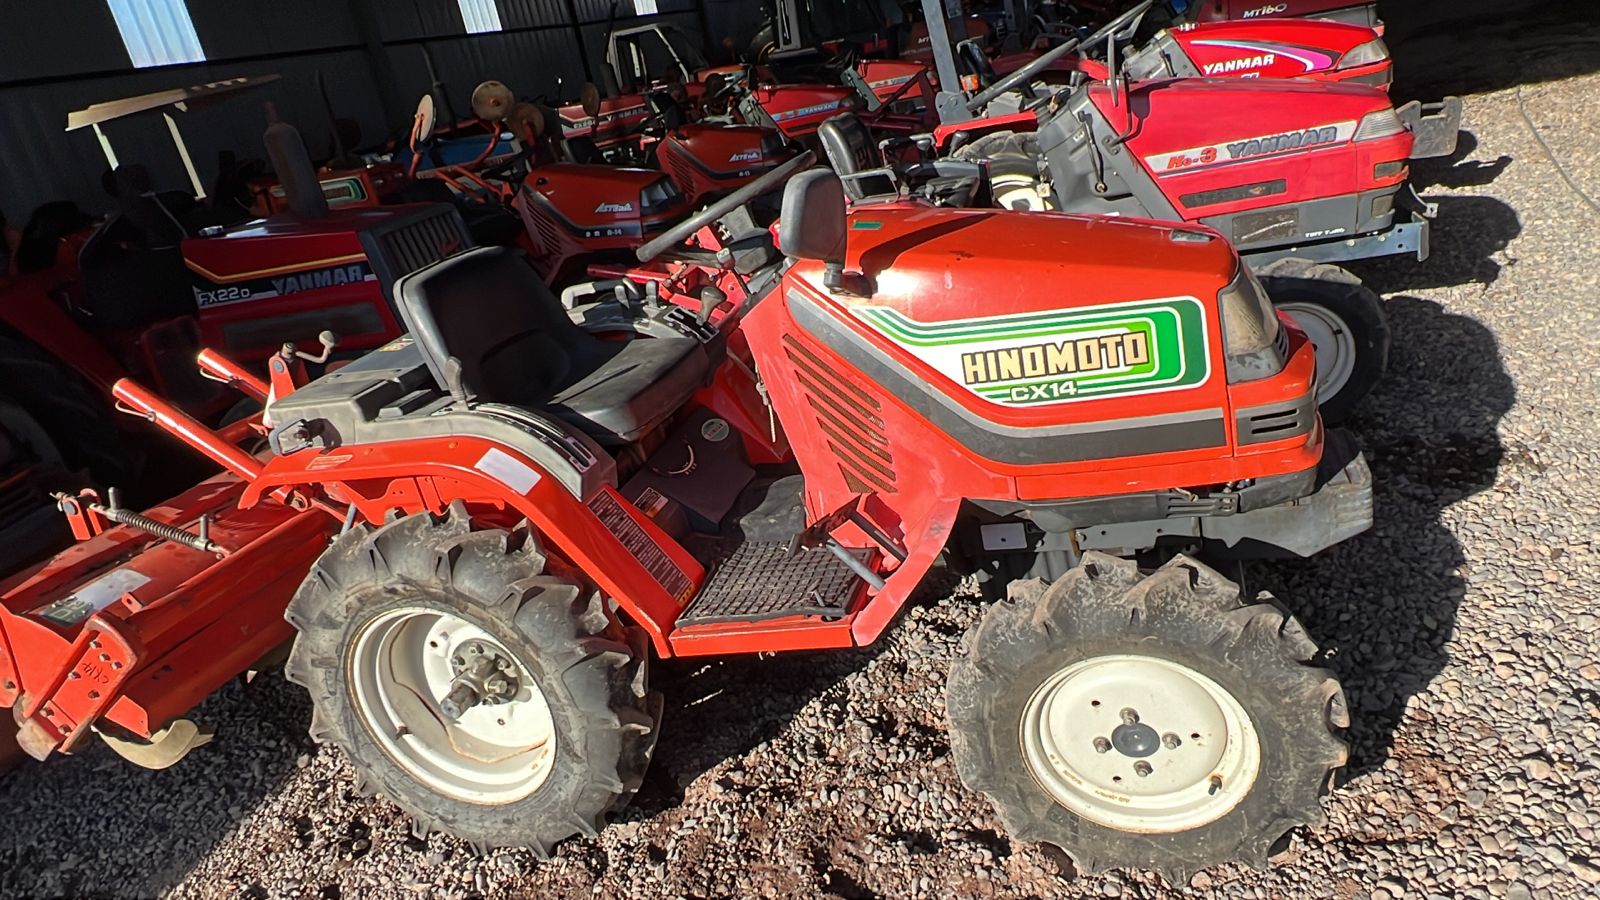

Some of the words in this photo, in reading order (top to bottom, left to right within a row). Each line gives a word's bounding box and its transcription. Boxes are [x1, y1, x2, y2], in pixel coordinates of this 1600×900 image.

[1203, 54, 1275, 75] YANMAR
[1226, 126, 1337, 159] YANMAR
[271, 265, 362, 295] YANMAR
[961, 331, 1149, 384] HINOMOTO
[1011, 380, 1077, 401] CX14
